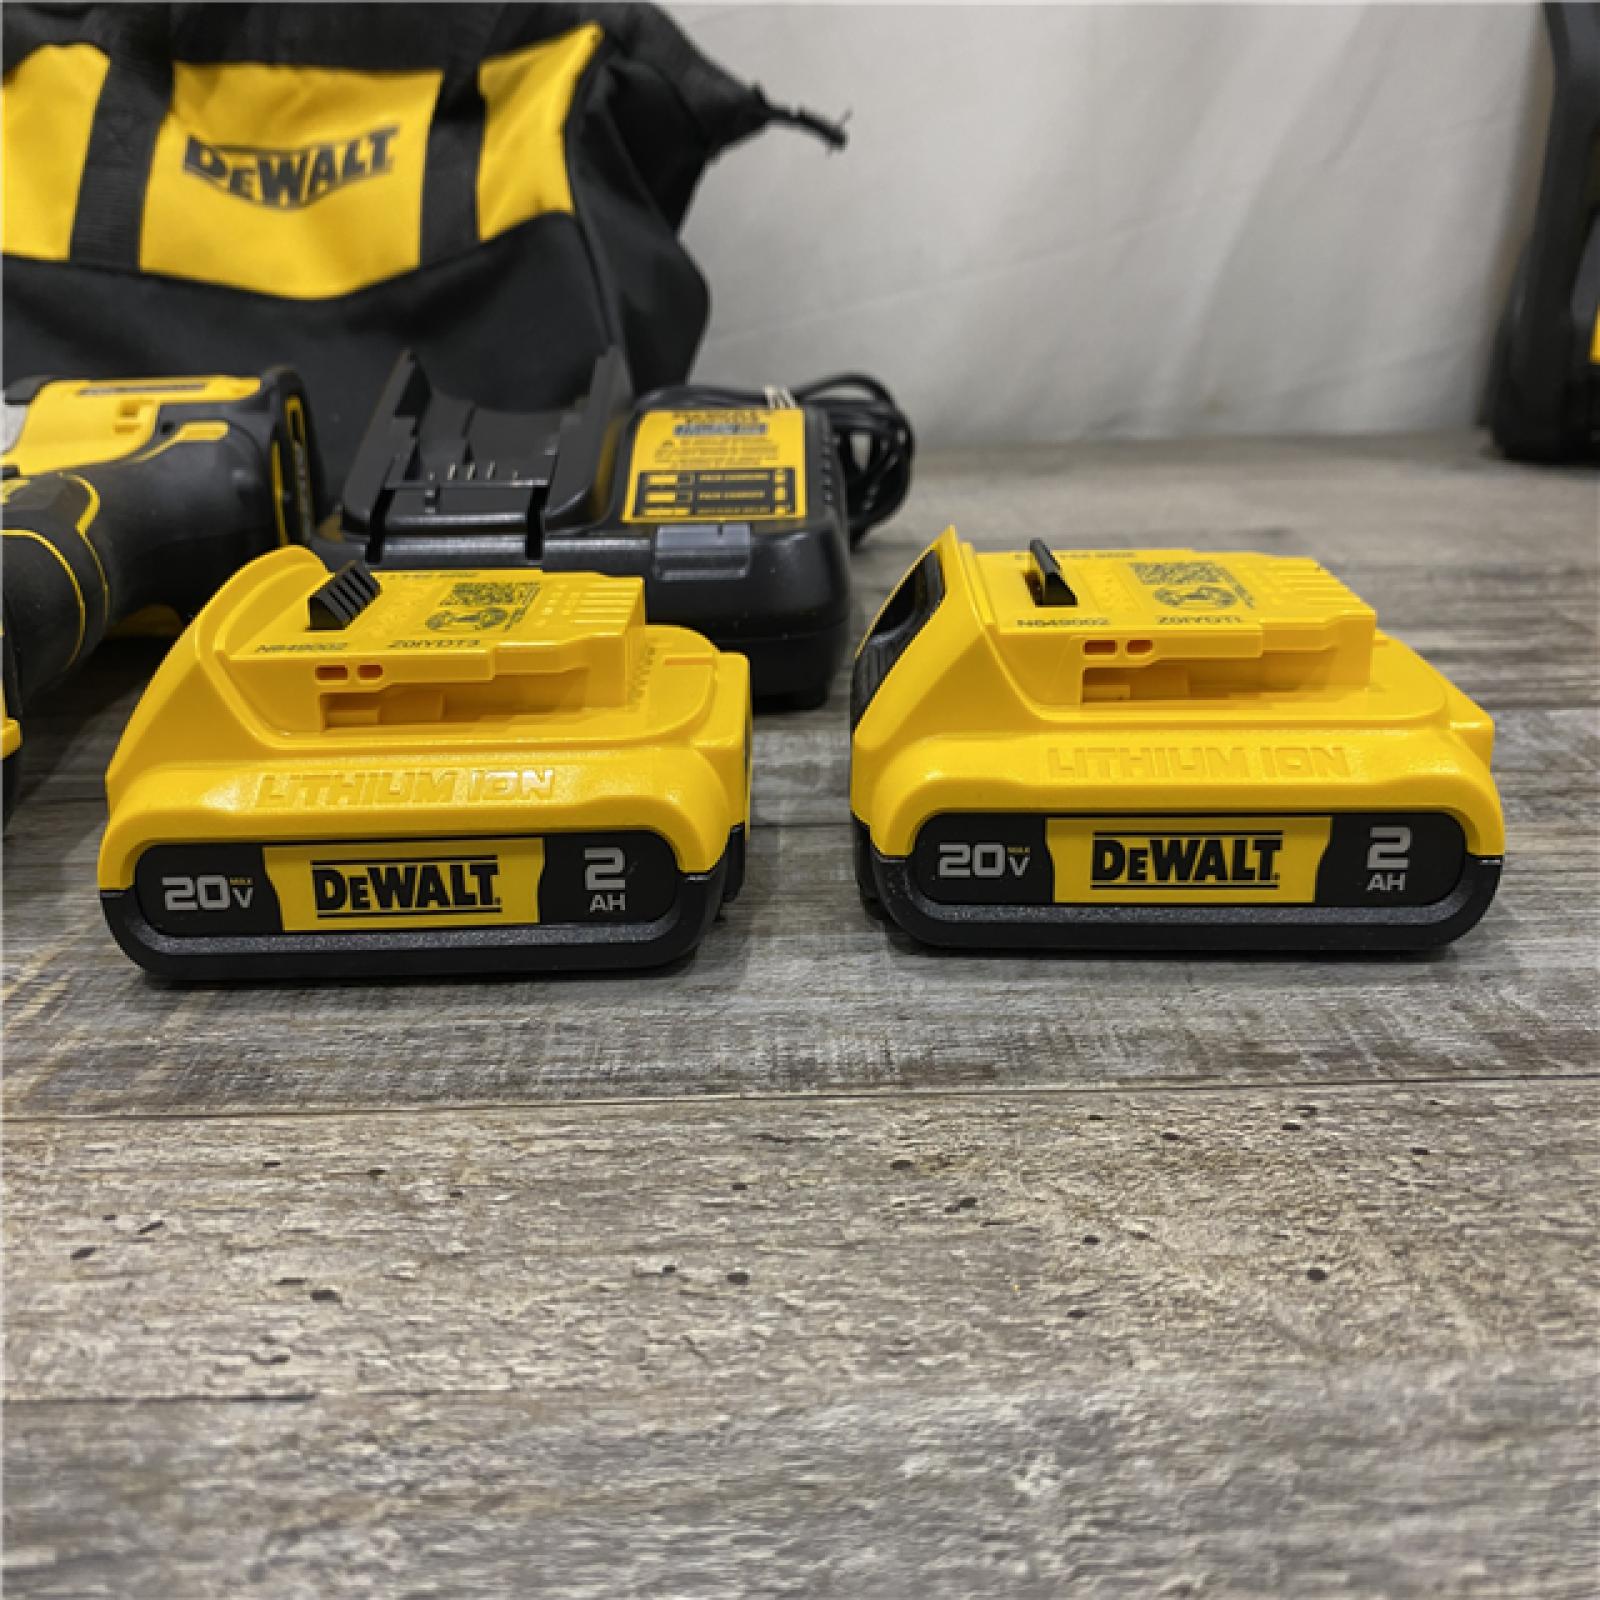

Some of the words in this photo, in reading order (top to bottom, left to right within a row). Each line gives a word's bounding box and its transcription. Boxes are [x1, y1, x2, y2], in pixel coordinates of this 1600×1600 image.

[1047, 746, 1254, 779] LITHIUM
[1260, 746, 1350, 779] ION
[254, 771, 459, 809] LITHIUM
[467, 768, 556, 802] ION
[1366, 826, 1412, 870] 2
[583, 847, 627, 890] 2
[1366, 873, 1405, 892] AH
[589, 894, 627, 912] AH
